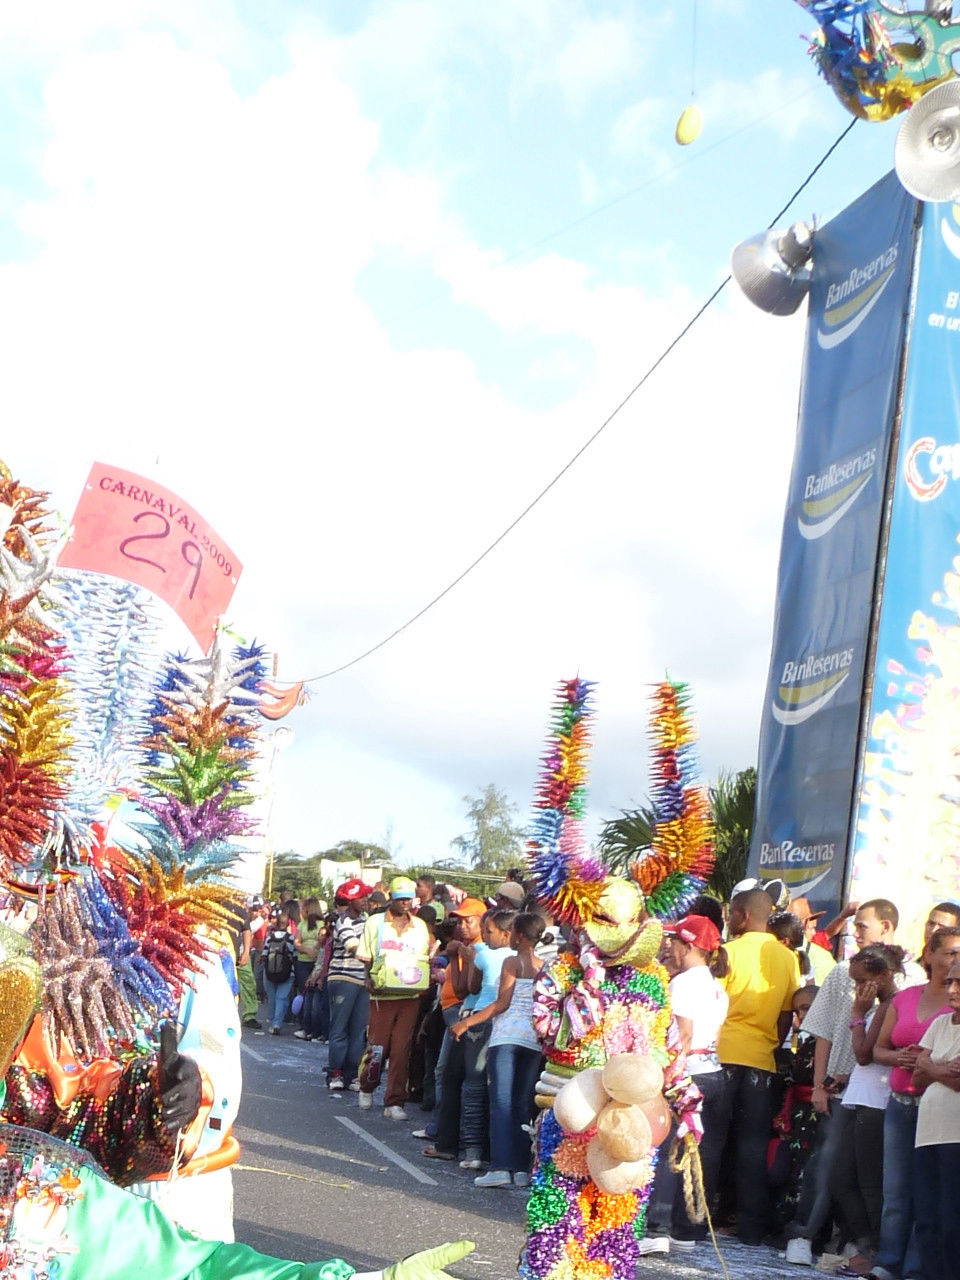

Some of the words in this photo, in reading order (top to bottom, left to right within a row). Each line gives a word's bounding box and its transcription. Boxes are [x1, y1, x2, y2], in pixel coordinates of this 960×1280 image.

[824, 242, 899, 310] BanReservas
[804, 448, 877, 499] BanReservas
[99, 476, 198, 539] CARNAVAL
[200, 536, 233, 577] 2009
[119, 511, 203, 601] 29
[781, 648, 854, 684] BanReservas
[759, 840, 835, 865] BanReservas
